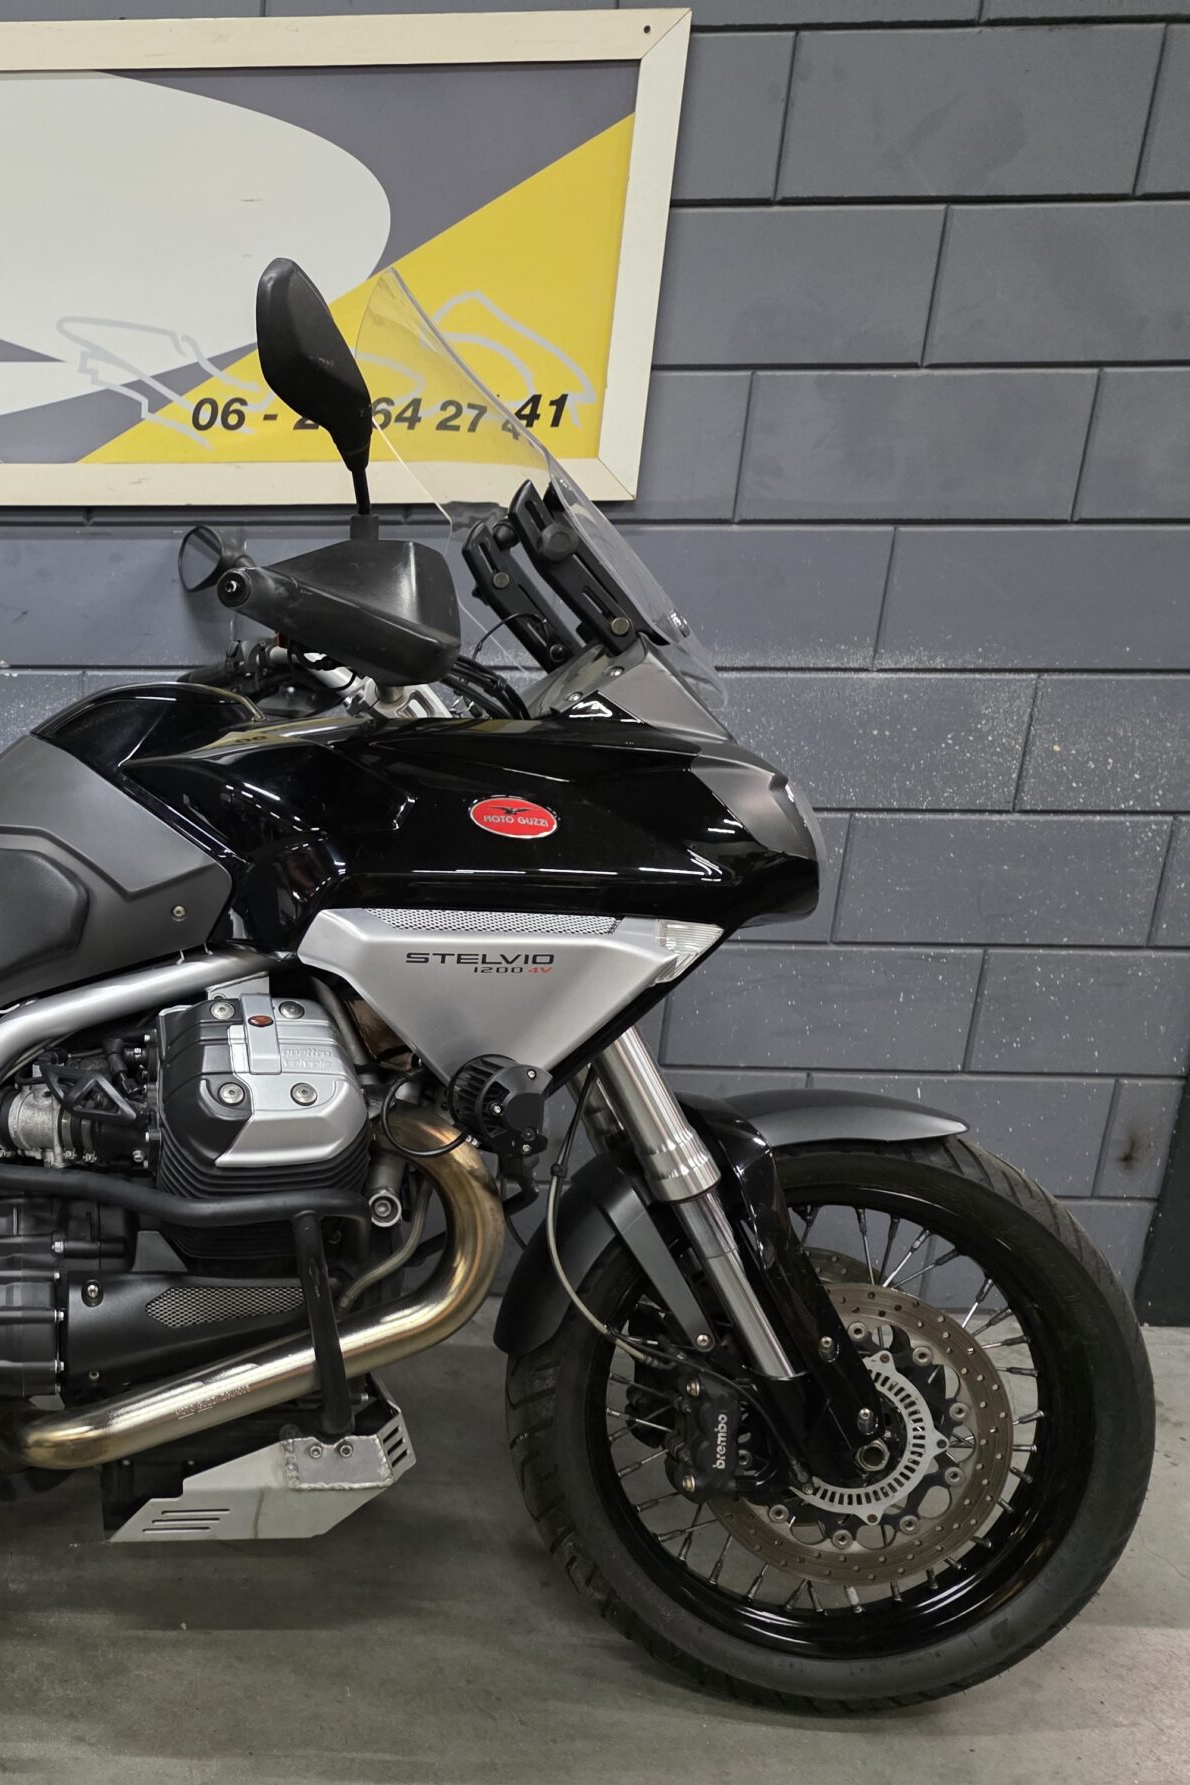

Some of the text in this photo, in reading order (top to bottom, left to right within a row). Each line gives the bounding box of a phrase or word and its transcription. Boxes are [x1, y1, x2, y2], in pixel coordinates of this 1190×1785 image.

[191, 397, 249, 432] 06
[435, 399, 488, 433] 27
[514, 393, 569, 428] 41
[483, 815, 549, 828] MOTO GUZZI
[406, 953, 554, 965] STELVIO
[474, 966, 553, 974] 1200 4V
[713, 1414, 728, 1469] brembo
